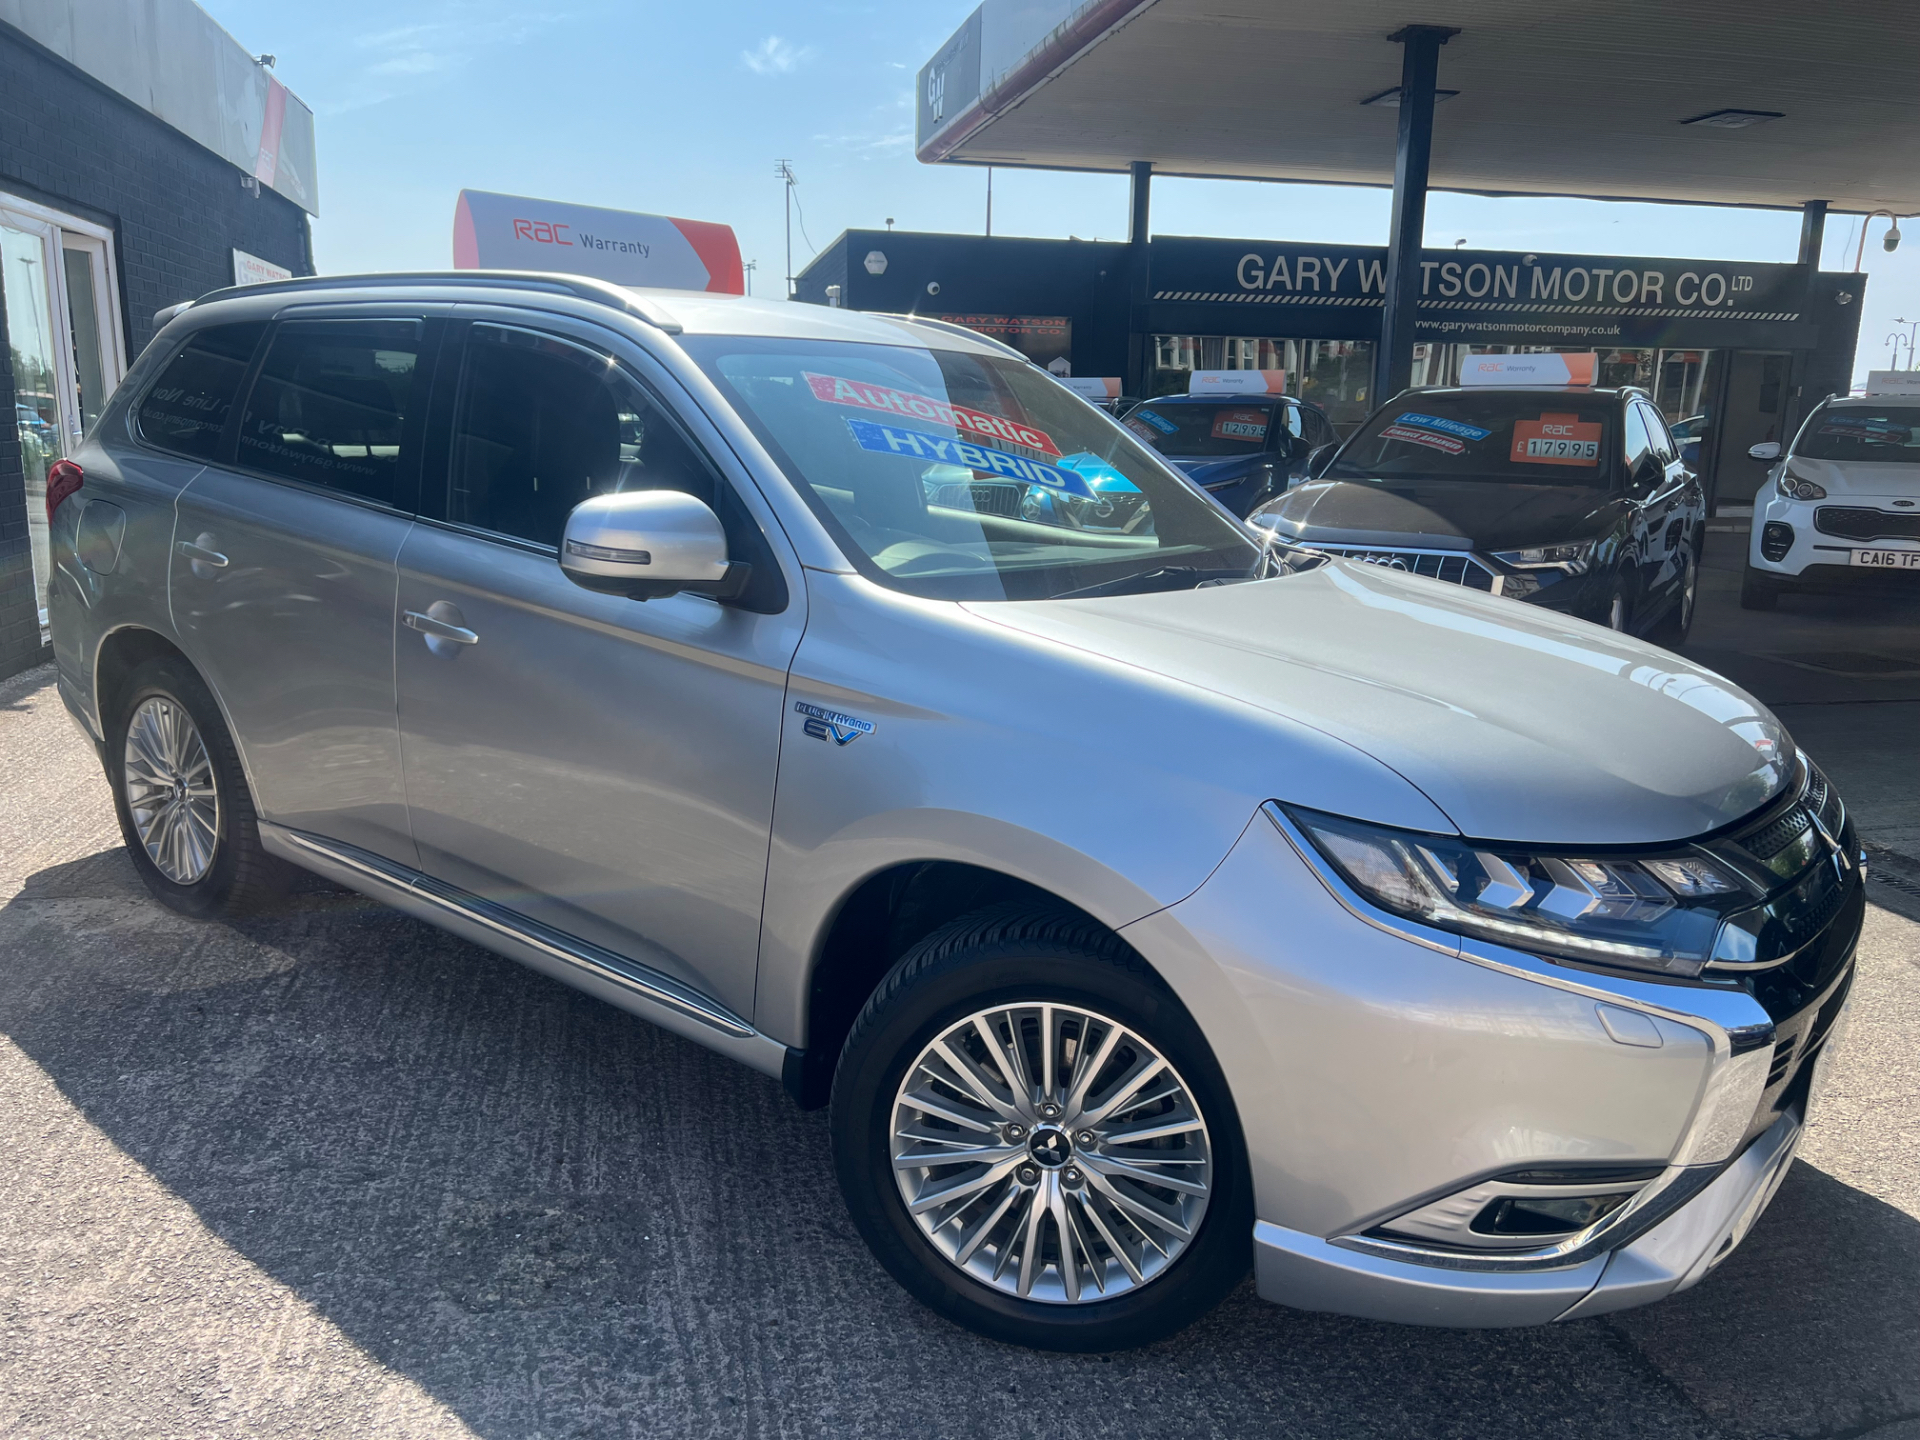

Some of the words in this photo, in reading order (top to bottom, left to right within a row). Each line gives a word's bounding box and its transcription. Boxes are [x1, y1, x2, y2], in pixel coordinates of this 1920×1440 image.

[579, 233, 650, 259] Warranty
[246, 260, 265, 274] GARY
[1237, 253, 1349, 292] GARY
[1358, 259, 1518, 299] WTSON
[1530, 266, 1664, 304] MOTOR
[1675, 271, 1733, 306] CO.
[1731, 275, 1753, 291] LTD
[941, 316, 988, 324] GARY
[994, 318, 1066, 326] WATSON
[971, 327, 1031, 335] MOTOR
[1507, 365, 1536, 373] Warranty
[833, 379, 1044, 449] Automatic
[1402, 413, 1429, 425] Low
[1431, 416, 1482, 437] Mileage
[881, 428, 1067, 488] HYBRID
[1860, 551, 1896, 566] CA16
[802, 716, 863, 747] EV
[833, 713, 872, 732] HYBRID
